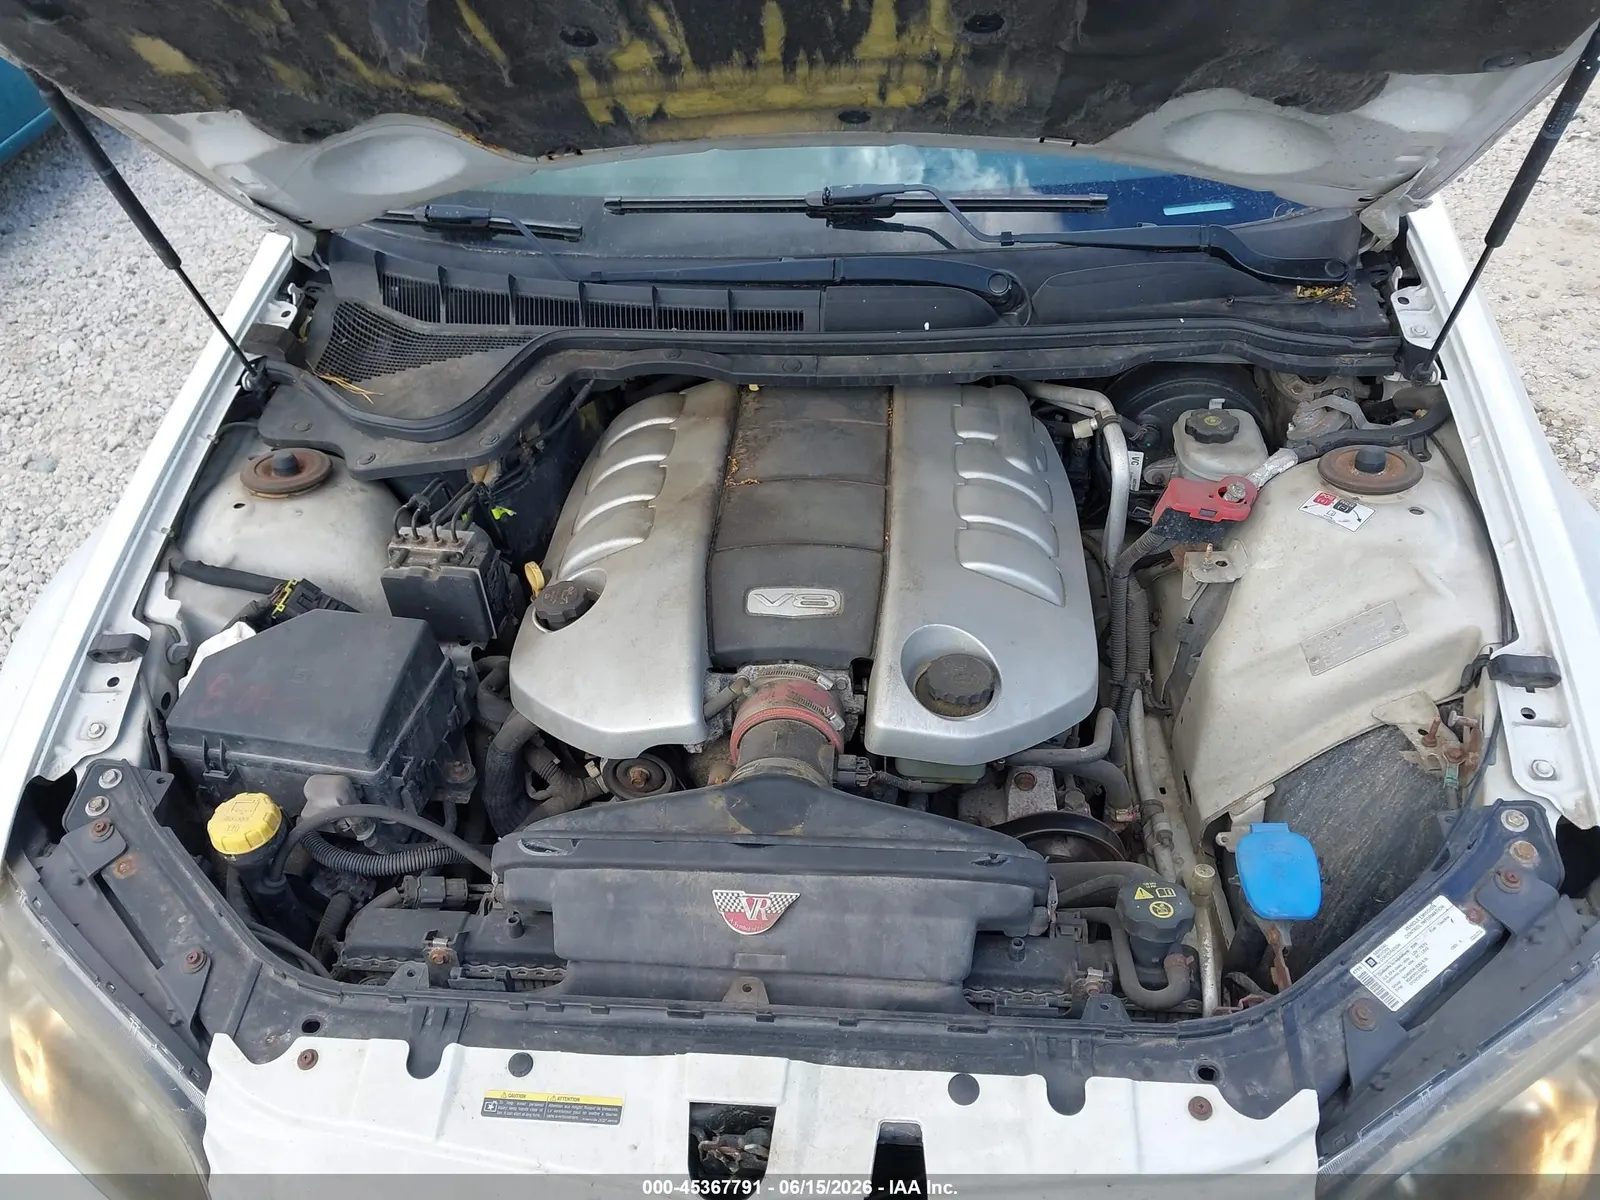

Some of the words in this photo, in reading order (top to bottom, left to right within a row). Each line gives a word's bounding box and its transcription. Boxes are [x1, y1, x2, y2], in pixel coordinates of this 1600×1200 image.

[1131, 457, 1140, 466] VC
[754, 592, 837, 609] V8
[738, 897, 771, 920] VR
[1404, 924, 1422, 938] CONTROL
[1420, 905, 1444, 924] INFORMATION
[1404, 918, 1420, 930] VEHICLE
